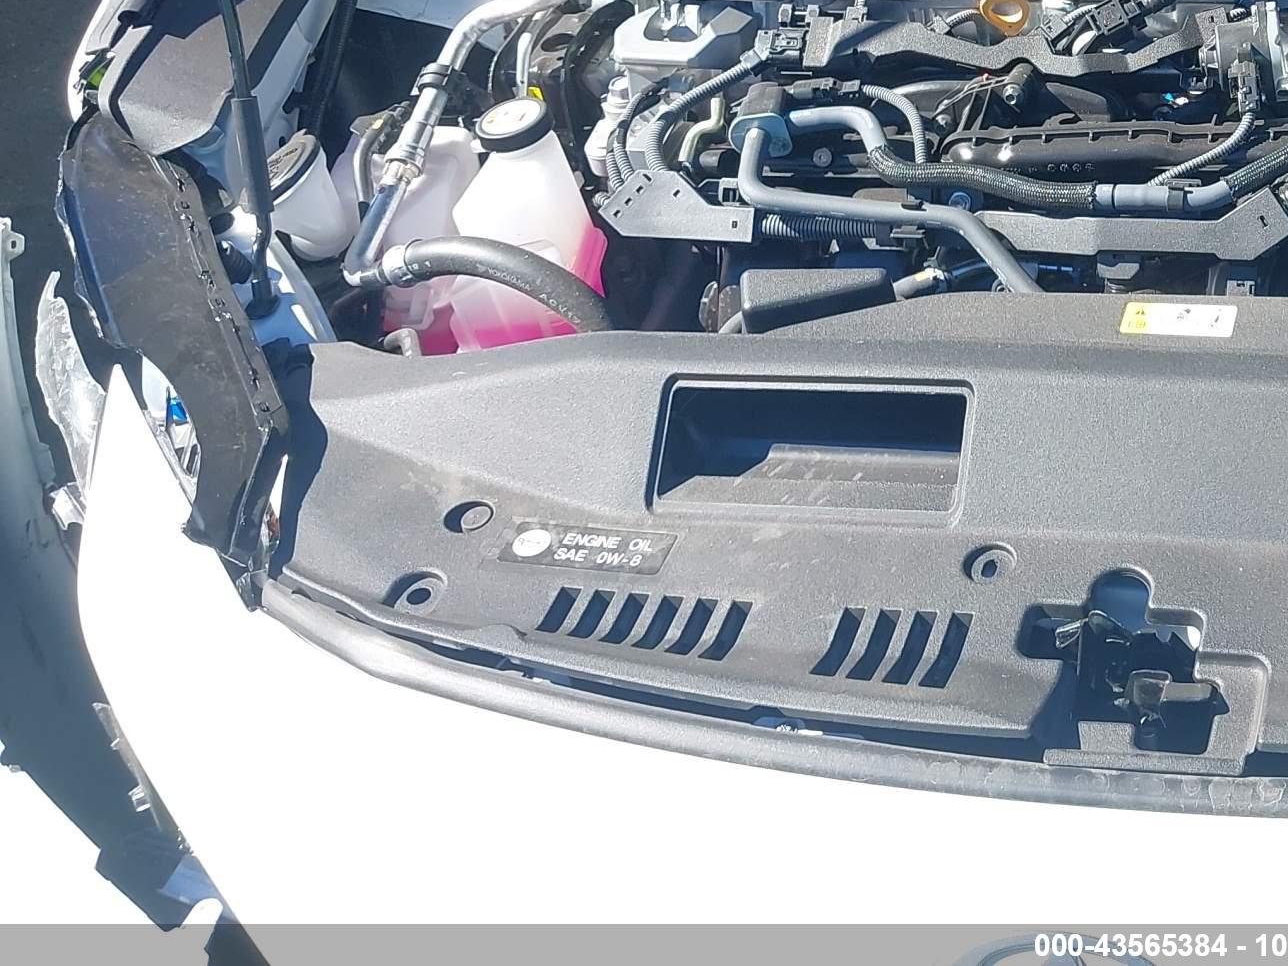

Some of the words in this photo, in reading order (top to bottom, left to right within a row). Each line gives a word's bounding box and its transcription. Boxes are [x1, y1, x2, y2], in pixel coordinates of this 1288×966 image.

[562, 532, 622, 549] ENGINE
[628, 537, 653, 552] OIL
[553, 547, 588, 562] SAE
[596, 552, 643, 566] 0W-8
